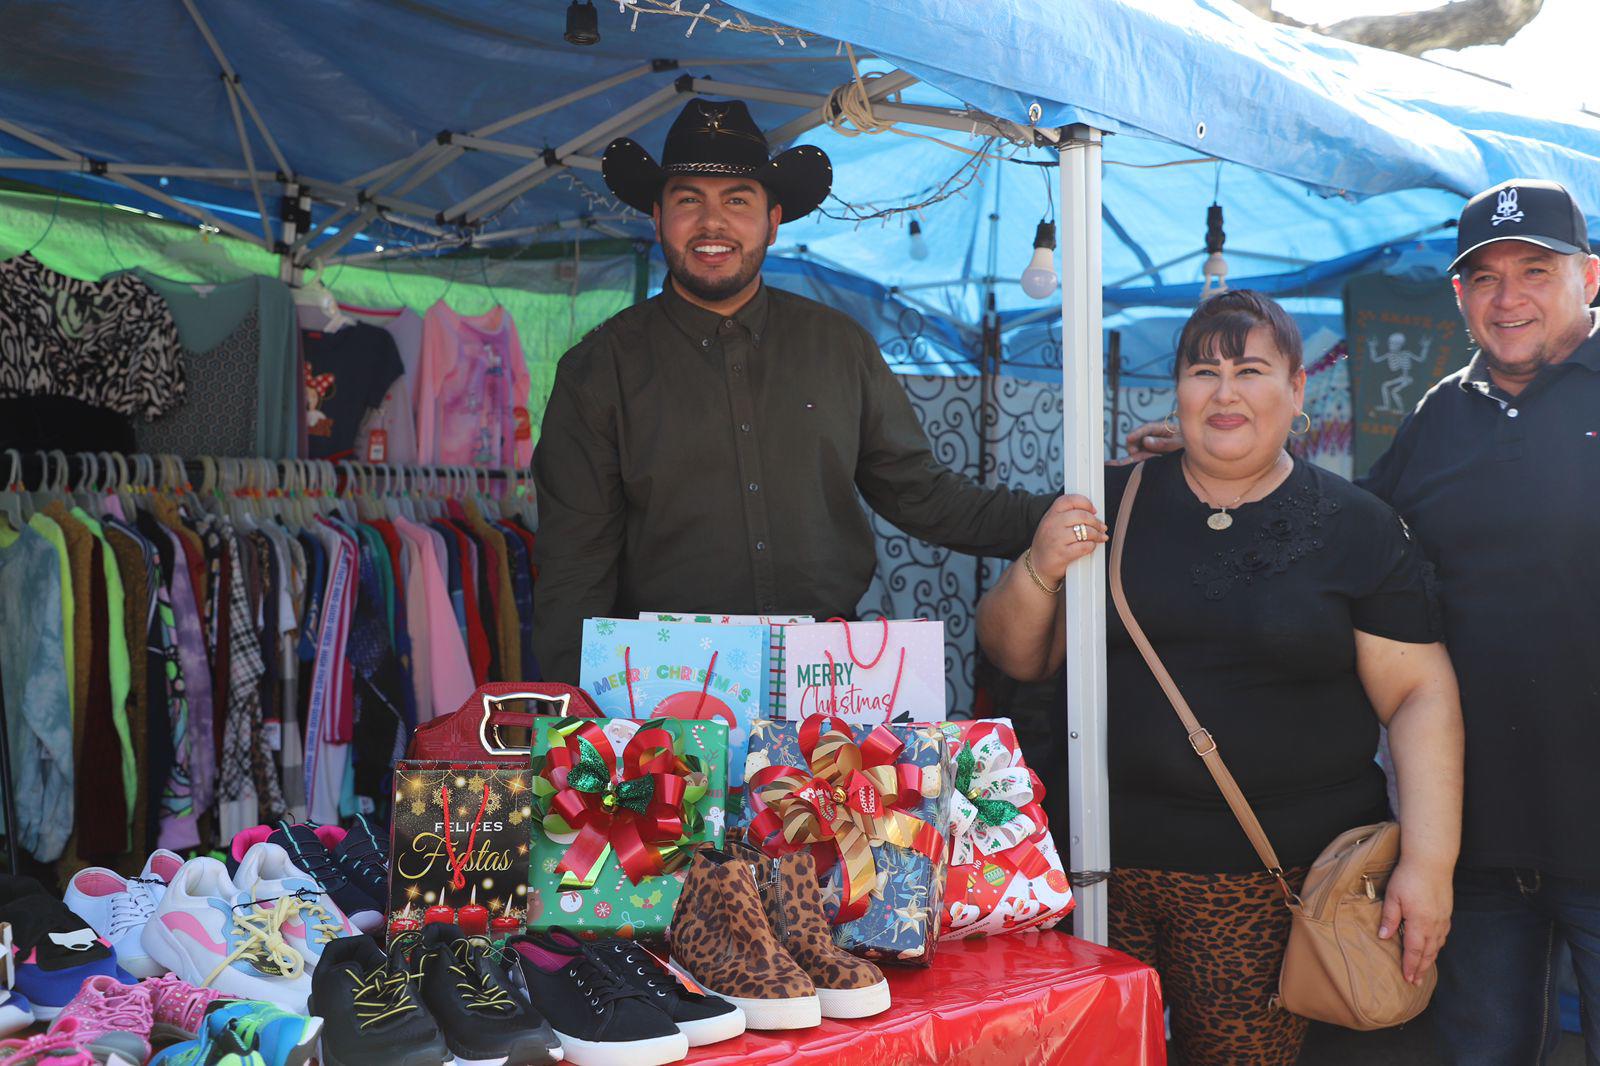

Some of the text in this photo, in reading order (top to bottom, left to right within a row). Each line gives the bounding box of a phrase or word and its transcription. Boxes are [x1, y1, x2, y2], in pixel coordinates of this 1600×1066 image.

[593, 664, 751, 703] MERRY CHRISTMAS
[797, 662, 853, 688] MERRY
[801, 683, 890, 720] Christmas
[435, 821, 503, 832] FELICES
